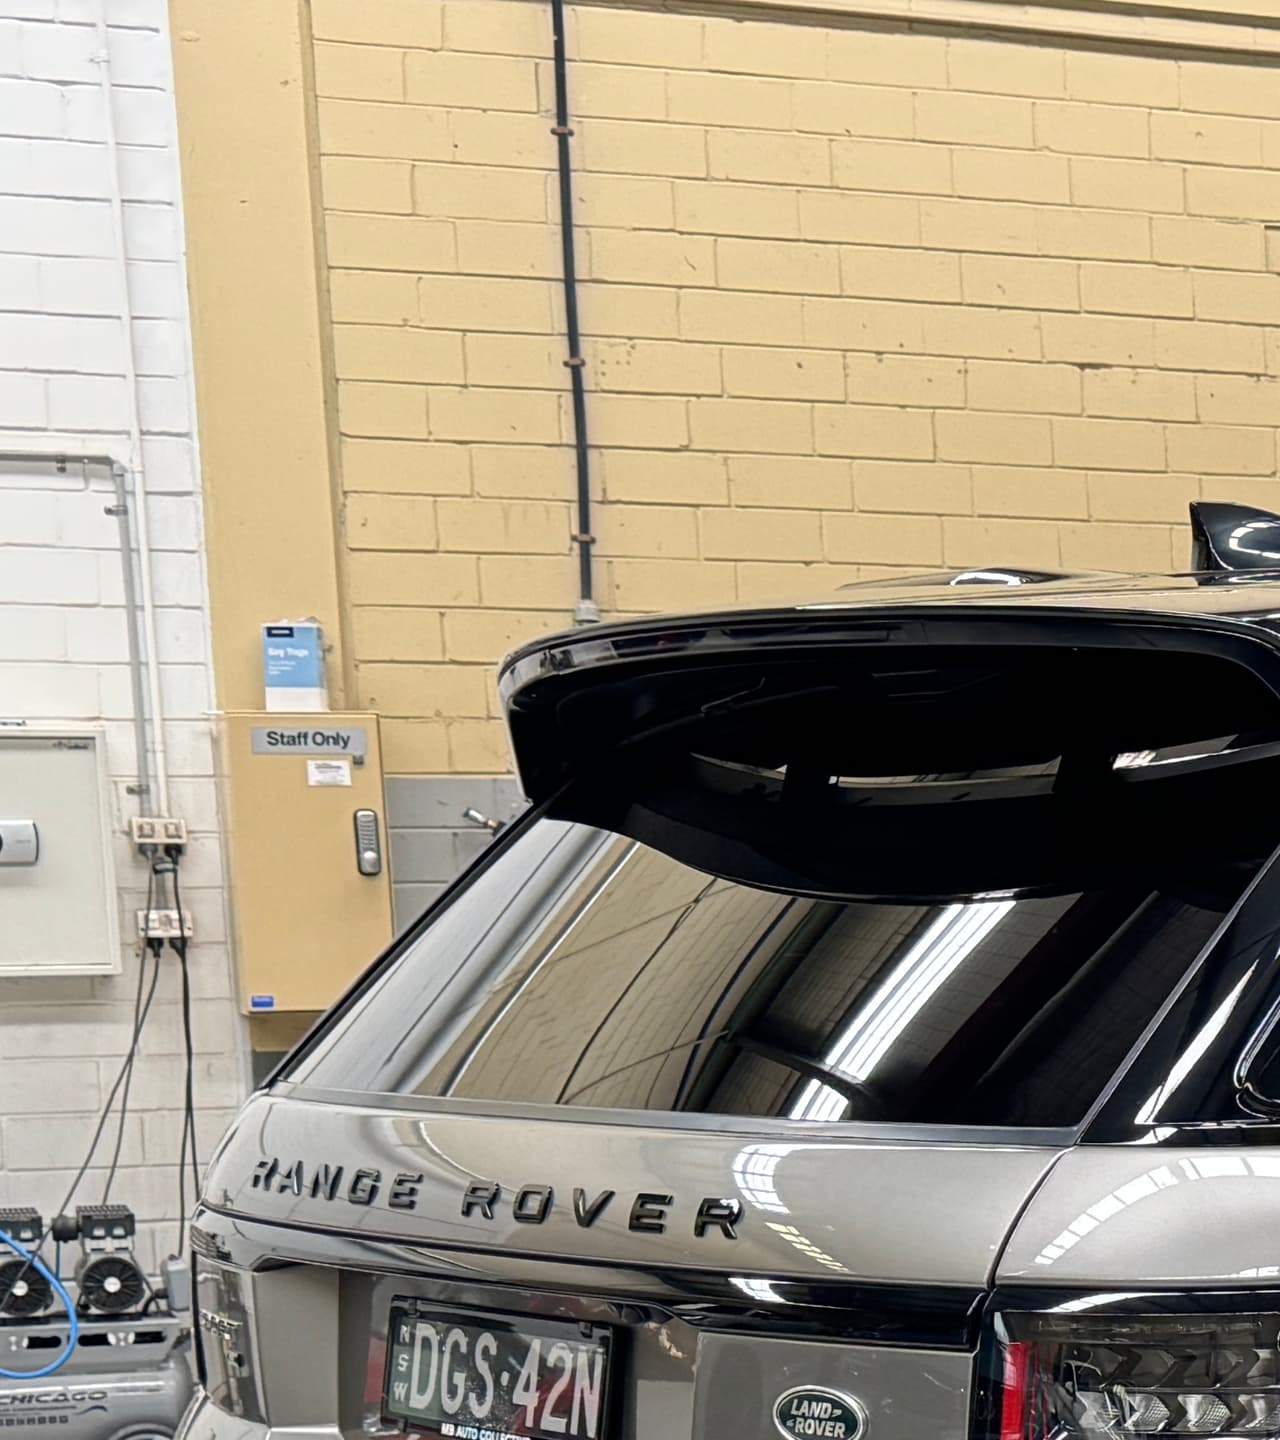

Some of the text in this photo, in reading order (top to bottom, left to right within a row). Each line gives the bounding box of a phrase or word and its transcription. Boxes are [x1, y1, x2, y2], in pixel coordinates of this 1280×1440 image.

[266, 731, 351, 750] Staff Only
[252, 1157, 744, 1240] RANGE ROVER
[790, 1398, 833, 1419] LAND
[441, 1422, 455, 1436] MB
[456, 1425, 478, 1440] AUTO
[795, 1417, 846, 1439] ROVER
